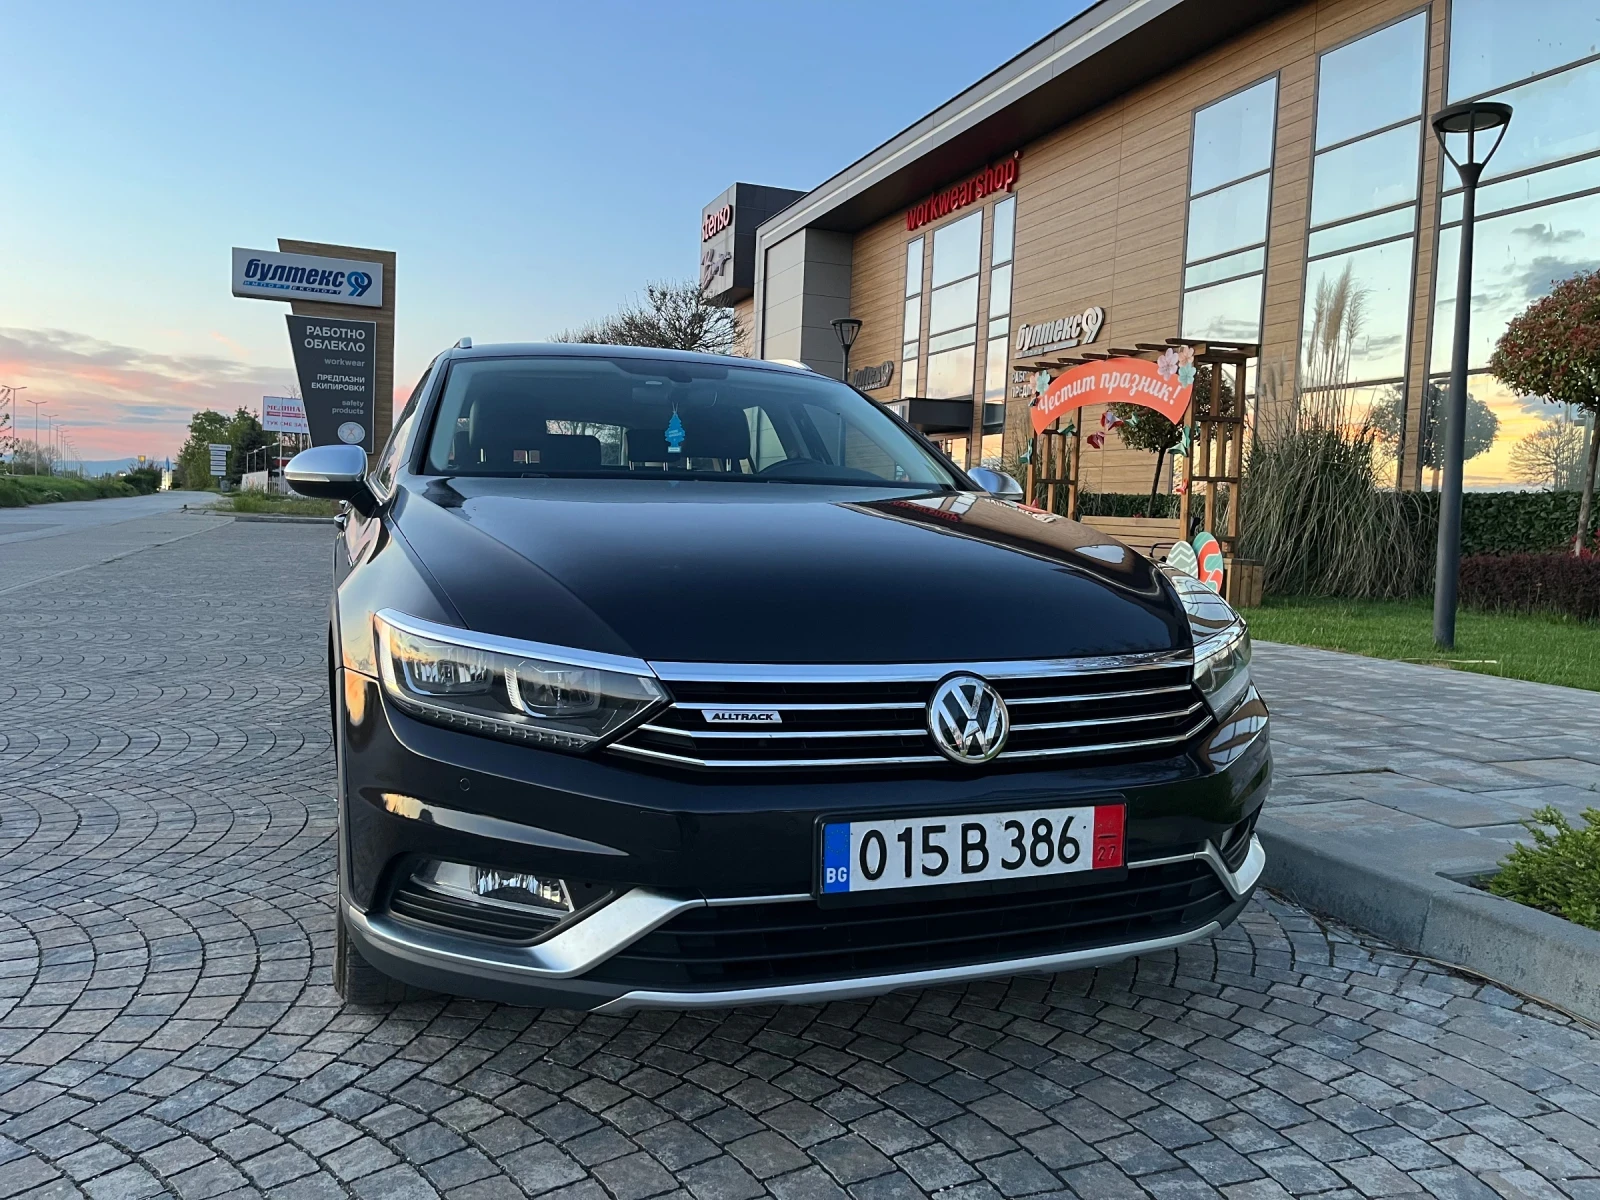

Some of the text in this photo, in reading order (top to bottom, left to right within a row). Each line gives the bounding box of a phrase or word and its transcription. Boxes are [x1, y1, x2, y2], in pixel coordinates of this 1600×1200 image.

[906, 157, 1018, 231] workwearshop
[702, 204, 732, 241] stenso
[244, 258, 346, 288] бултекс
[306, 325, 366, 340] РАБОТНО
[1015, 314, 1083, 350] бултекс
[304, 338, 366, 352] ОБЛЕКЛО
[324, 358, 365, 367] workwear
[316, 374, 365, 384] ПРЕДПАЗНИ
[311, 382, 365, 392] ЕКИПИРОВКИ
[1038, 371, 1182, 414] Честит празник!
[332, 407, 364, 415] products
[341, 400, 364, 408] safety
[711, 712, 775, 722] ALLTRACK
[1097, 844, 1116, 861] 27
[826, 866, 848, 884] BG
